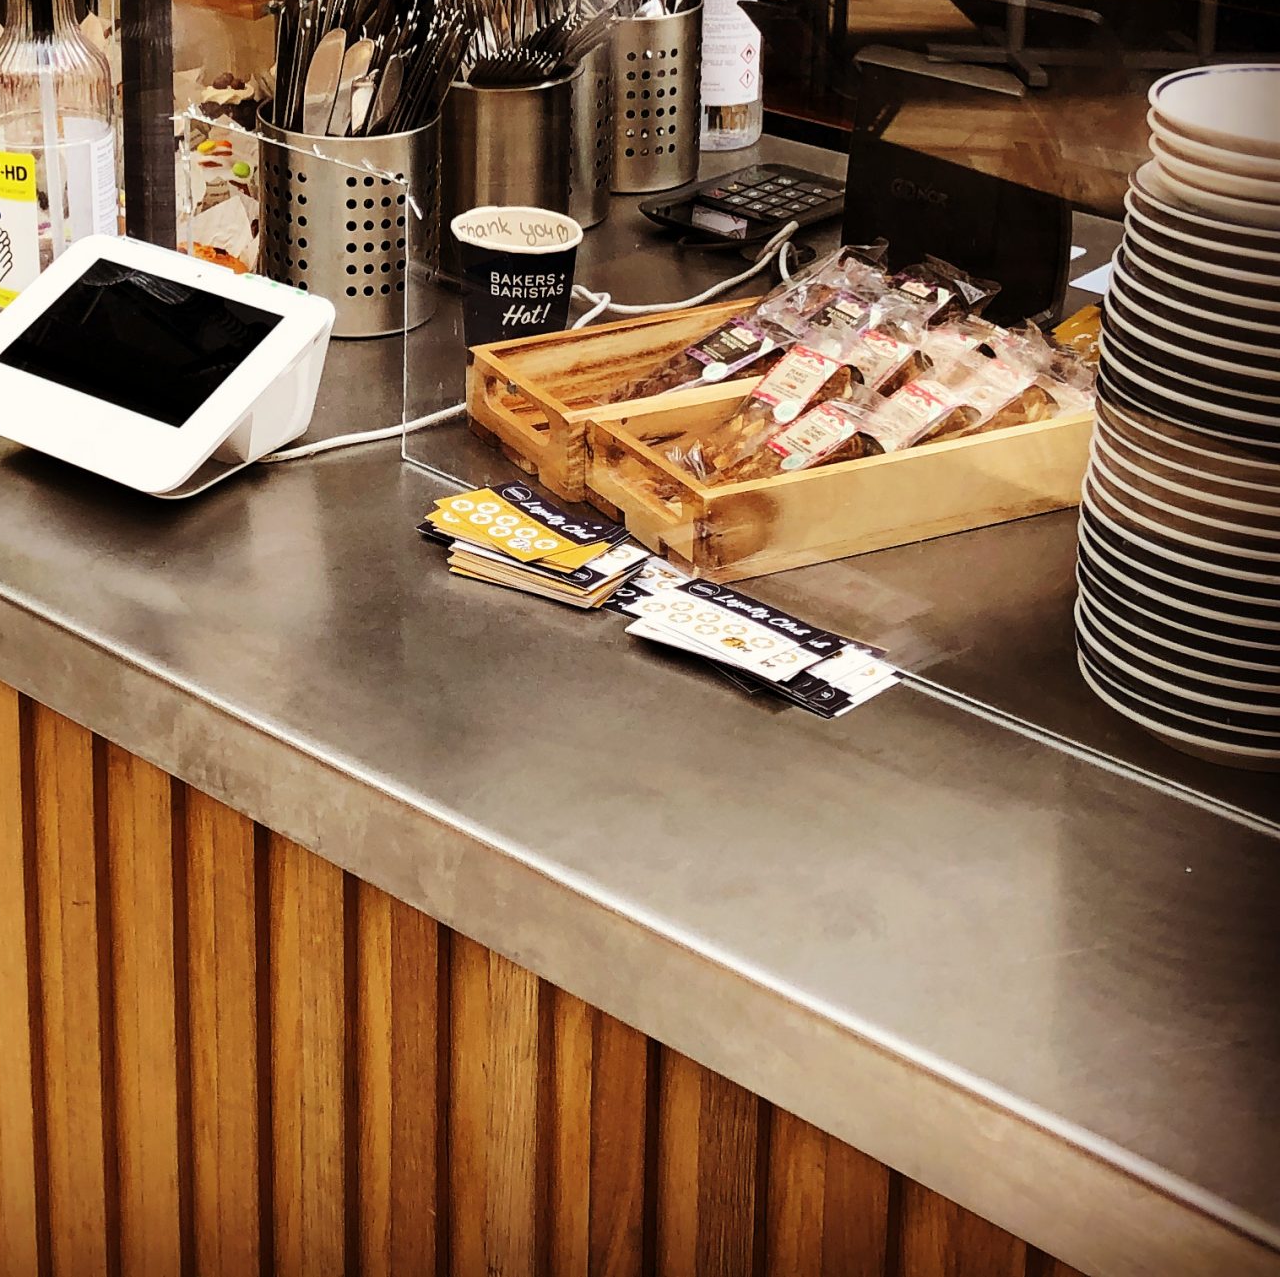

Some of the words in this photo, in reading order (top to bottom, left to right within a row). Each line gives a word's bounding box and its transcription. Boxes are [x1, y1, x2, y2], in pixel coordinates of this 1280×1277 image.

[491, 271, 555, 286] BAKERS
[491, 284, 564, 299] BARISTAS
[502, 303, 551, 326] Hot!
[520, 501, 566, 526] Loyalty
[561, 524, 597, 540] Club
[713, 594, 771, 620] Loyalty
[768, 616, 813, 638] Club
